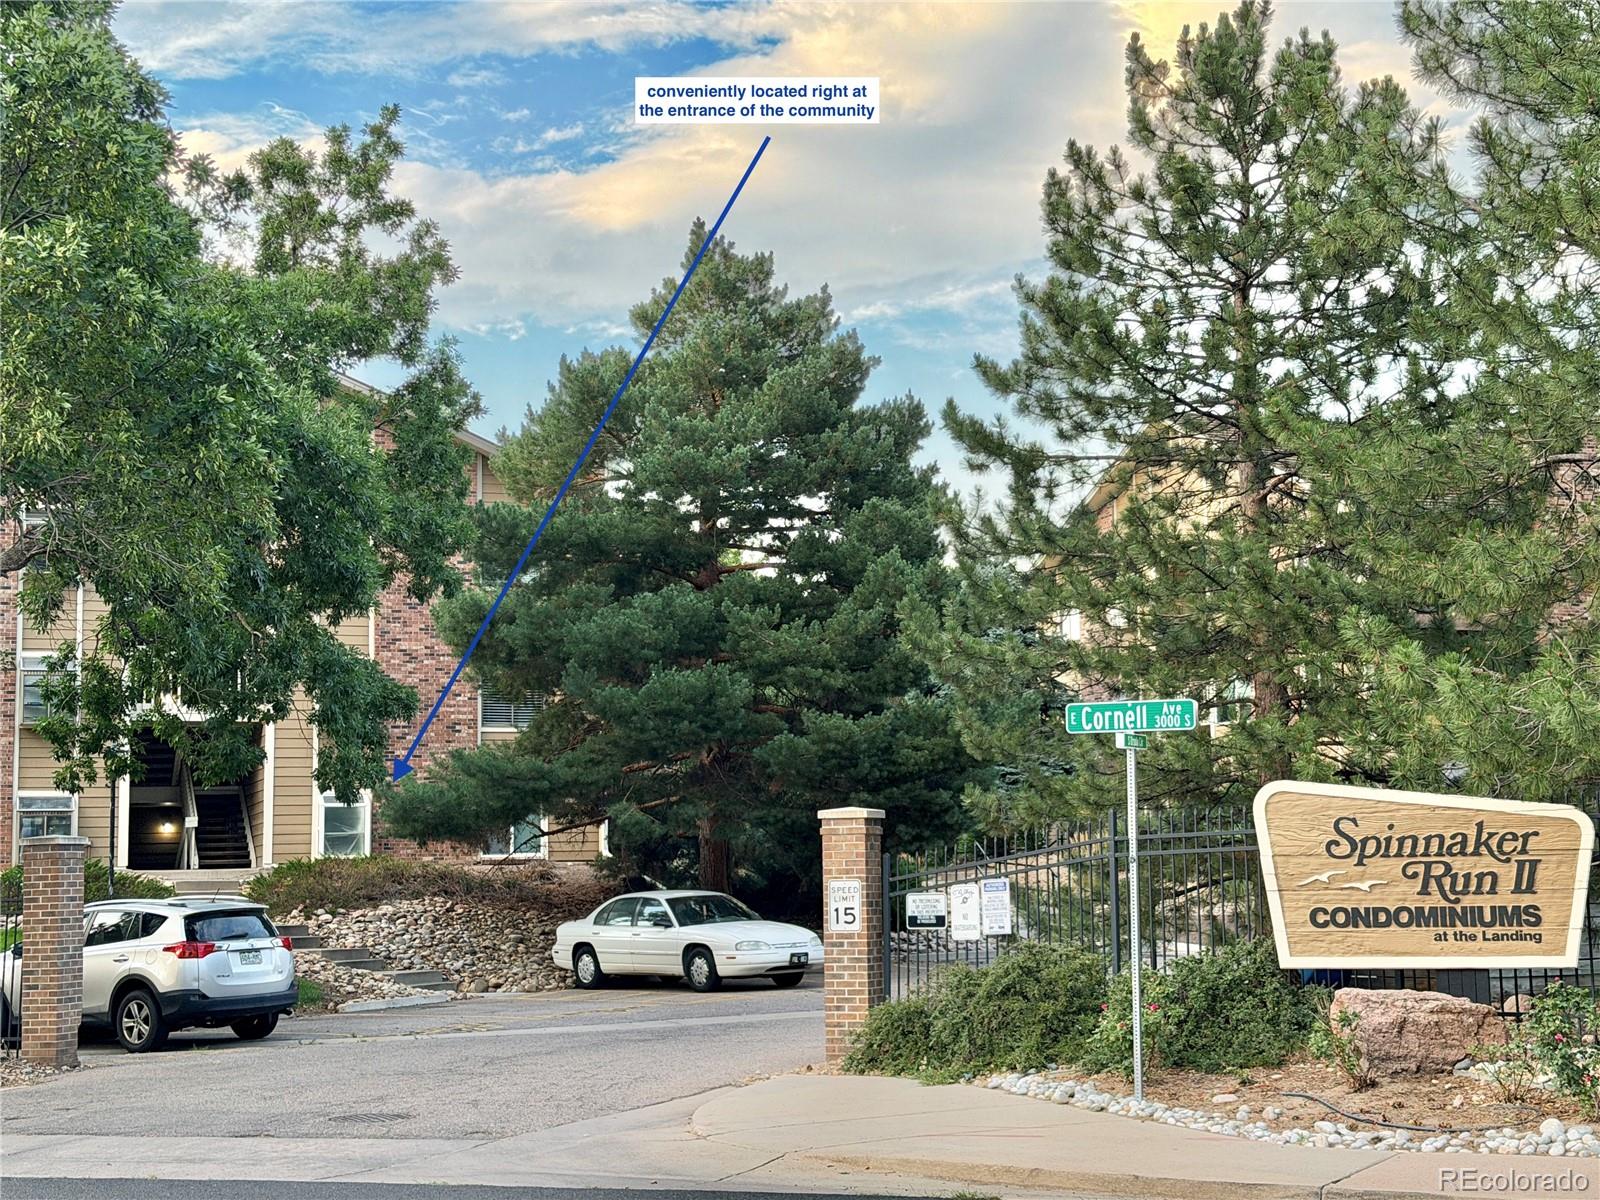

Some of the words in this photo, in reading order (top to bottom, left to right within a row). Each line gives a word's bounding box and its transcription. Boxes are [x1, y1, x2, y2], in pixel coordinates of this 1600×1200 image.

[1070, 712, 1077, 726] E
[1081, 705, 1147, 731] Cornell
[1162, 702, 1182, 715] Ave
[1154, 715, 1181, 728] 3000
[1184, 714, 1191, 727] S
[1325, 816, 1540, 867] Spinnaker
[831, 886, 859, 894] SPEED
[1401, 859, 1499, 905] Run
[1510, 859, 1542, 895] II
[833, 895, 855, 903] LIMIT
[833, 907, 856, 925] 15
[1309, 904, 1543, 929] CONDOMINIUMS
[1433, 931, 1449, 942] at
[1453, 930, 1478, 942] the
[1482, 930, 1543, 944] Landing
